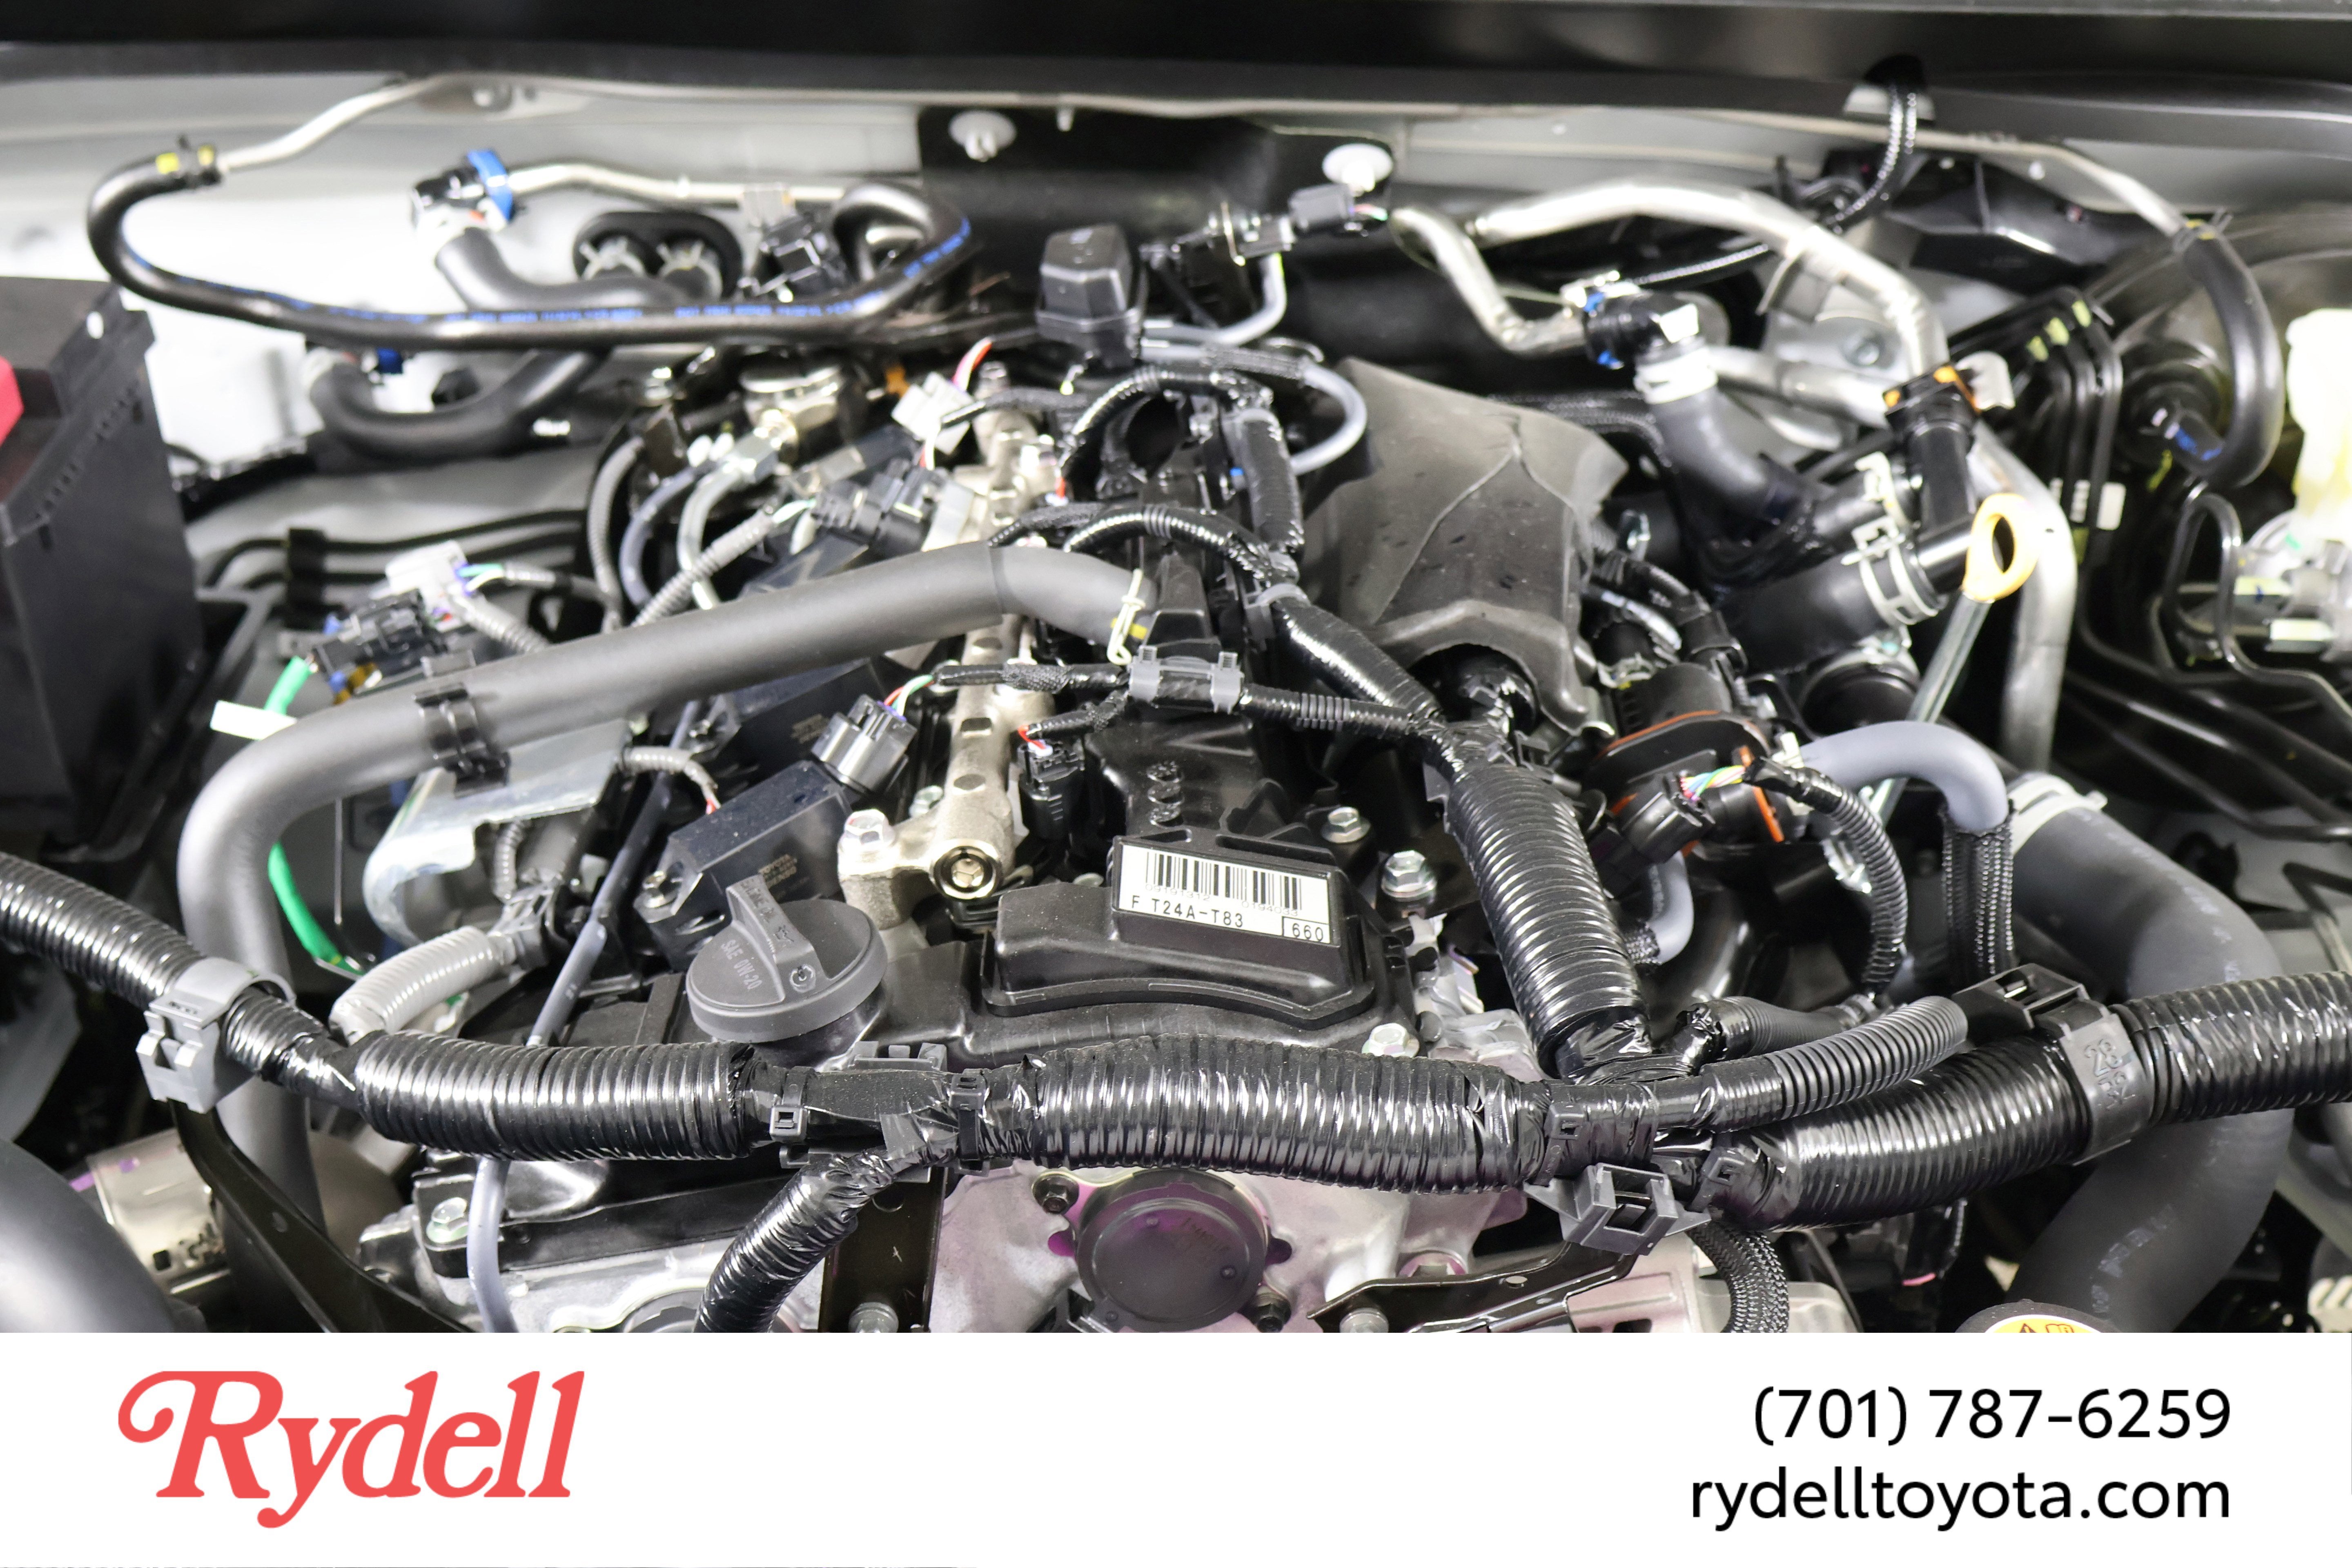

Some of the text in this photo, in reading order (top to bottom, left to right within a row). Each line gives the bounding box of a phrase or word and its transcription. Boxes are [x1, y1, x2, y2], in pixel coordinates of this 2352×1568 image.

[1145, 884, 1210, 902] 09191312
[1131, 895, 1243, 927] F T24A-T83
[1242, 900, 1298, 916] 0194033
[1292, 922, 1323, 942] 660
[721, 940, 762, 990] SAE 0W-20
